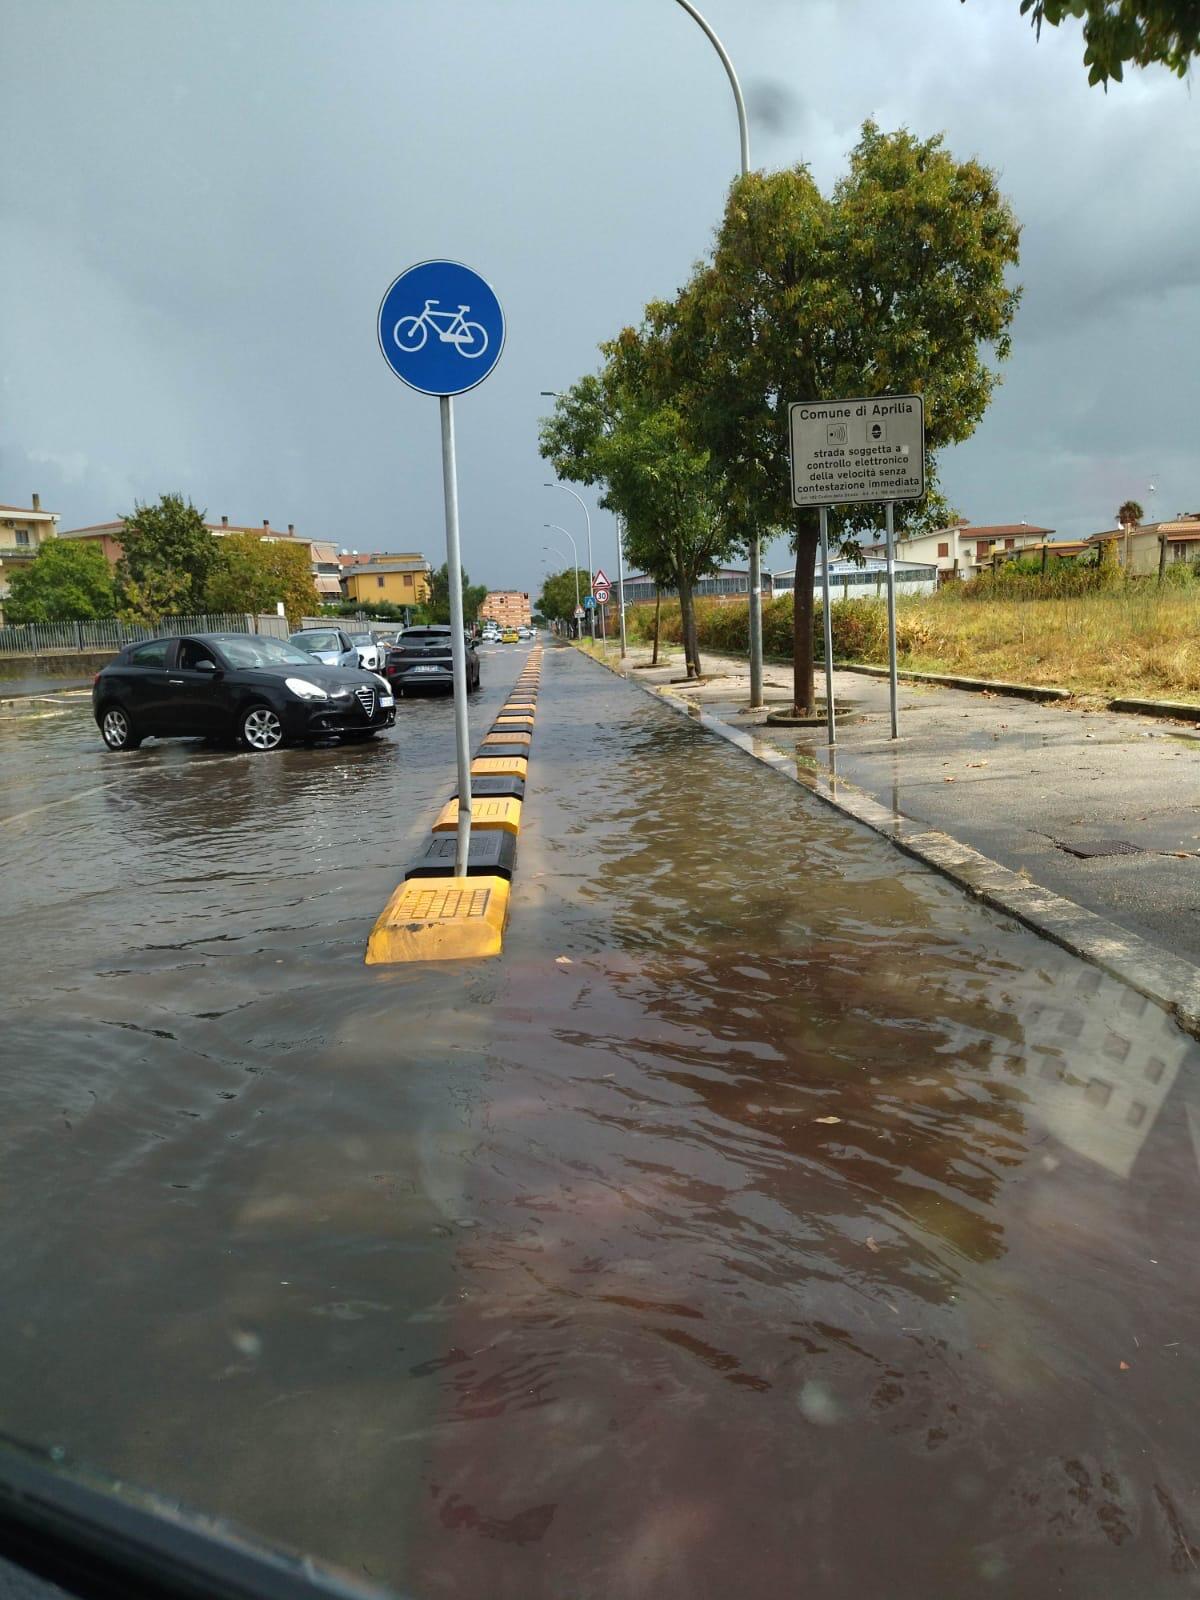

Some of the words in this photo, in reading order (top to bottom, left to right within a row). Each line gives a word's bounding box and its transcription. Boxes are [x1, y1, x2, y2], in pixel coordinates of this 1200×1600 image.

[800, 408, 851, 420] Comune
[856, 406, 867, 416] di
[872, 402, 913, 416] Aprilia
[814, 447, 845, 458] strada
[849, 445, 892, 456] soggetta
[807, 459, 852, 470] controllo
[855, 456, 909, 467] elettronico
[810, 472, 834, 481] della
[837, 468, 876, 479] velocità
[879, 467, 907, 476] senza
[797, 481, 865, 493] contestazione
[869, 477, 920, 488] immediata
